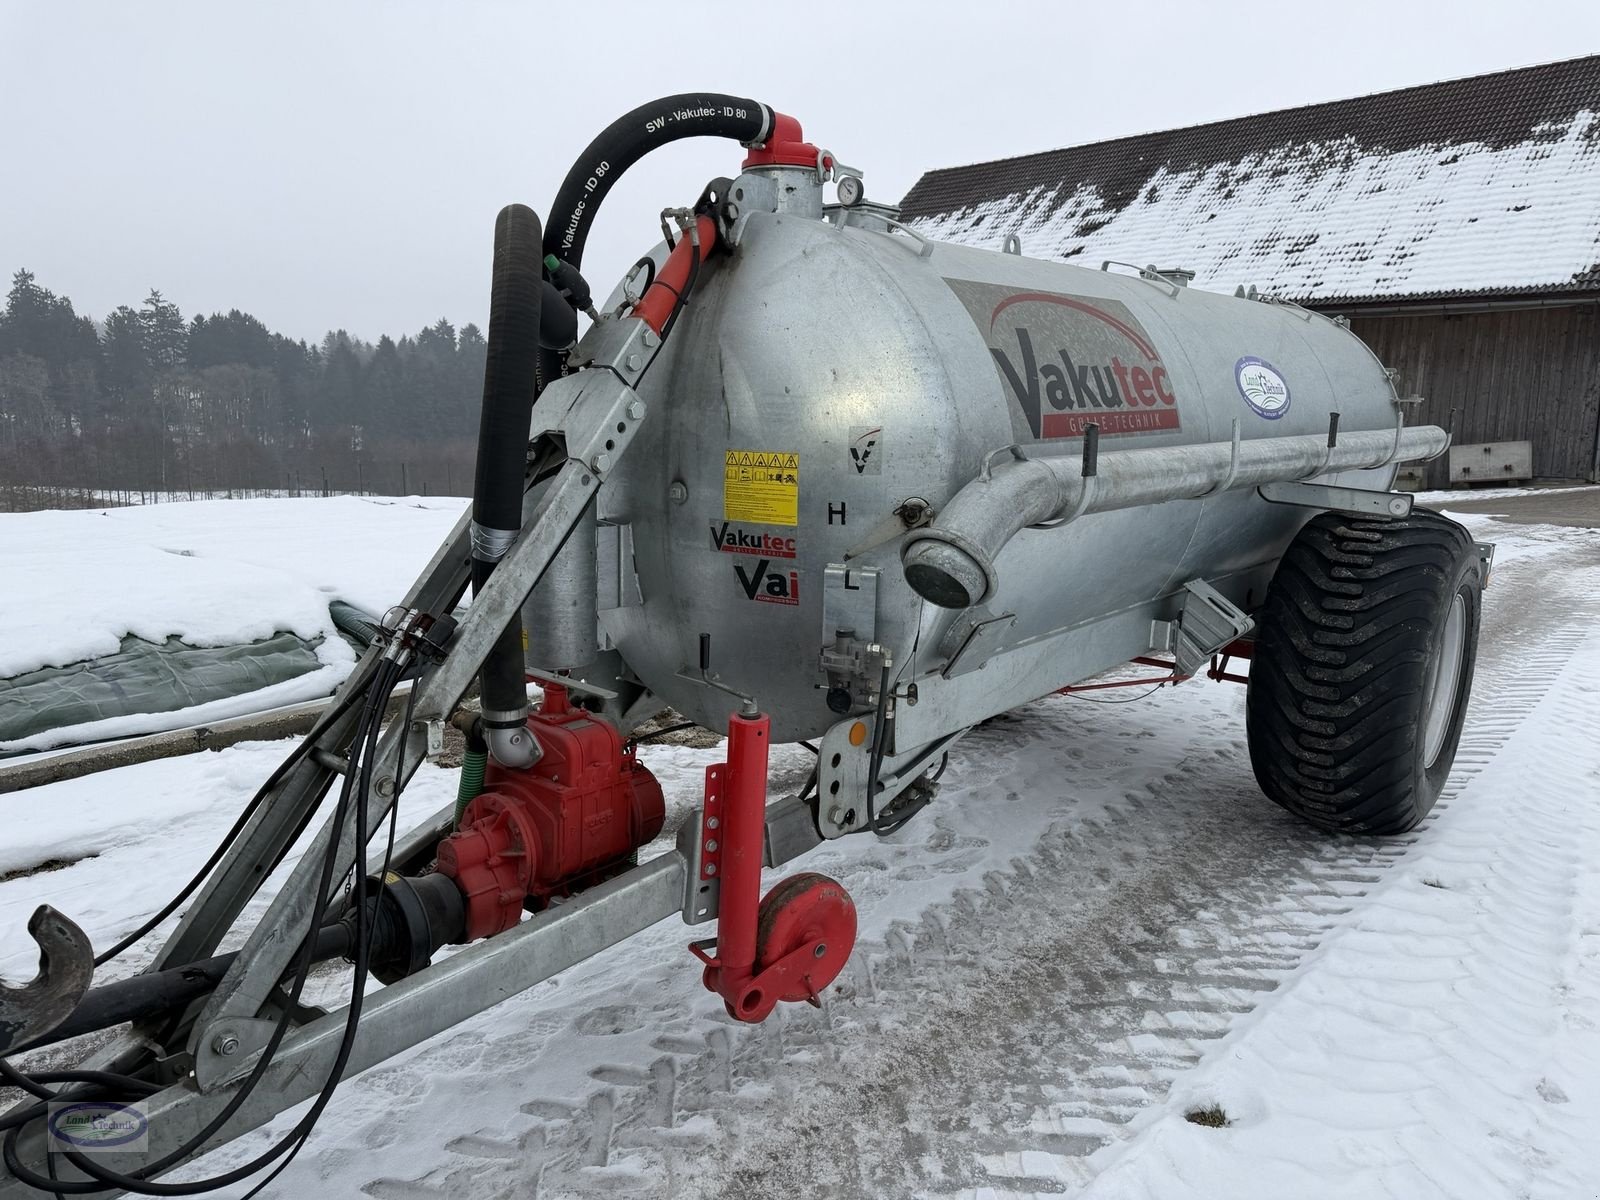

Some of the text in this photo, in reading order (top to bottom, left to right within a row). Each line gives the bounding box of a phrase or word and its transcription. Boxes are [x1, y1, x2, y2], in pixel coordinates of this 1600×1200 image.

[646, 116, 665, 134] SW
[673, 107, 716, 121] Vakutec
[723, 106, 734, 117] ID
[736, 108, 747, 120] 80
[561, 200, 586, 251] Vakutec
[585, 177, 598, 193] ID
[596, 161, 610, 177] 80
[989, 328, 1176, 439] Vakutec
[828, 502, 846, 525] H
[710, 522, 796, 551] Vakutec
[734, 559, 799, 600] Vai
[845, 569, 859, 590] L
